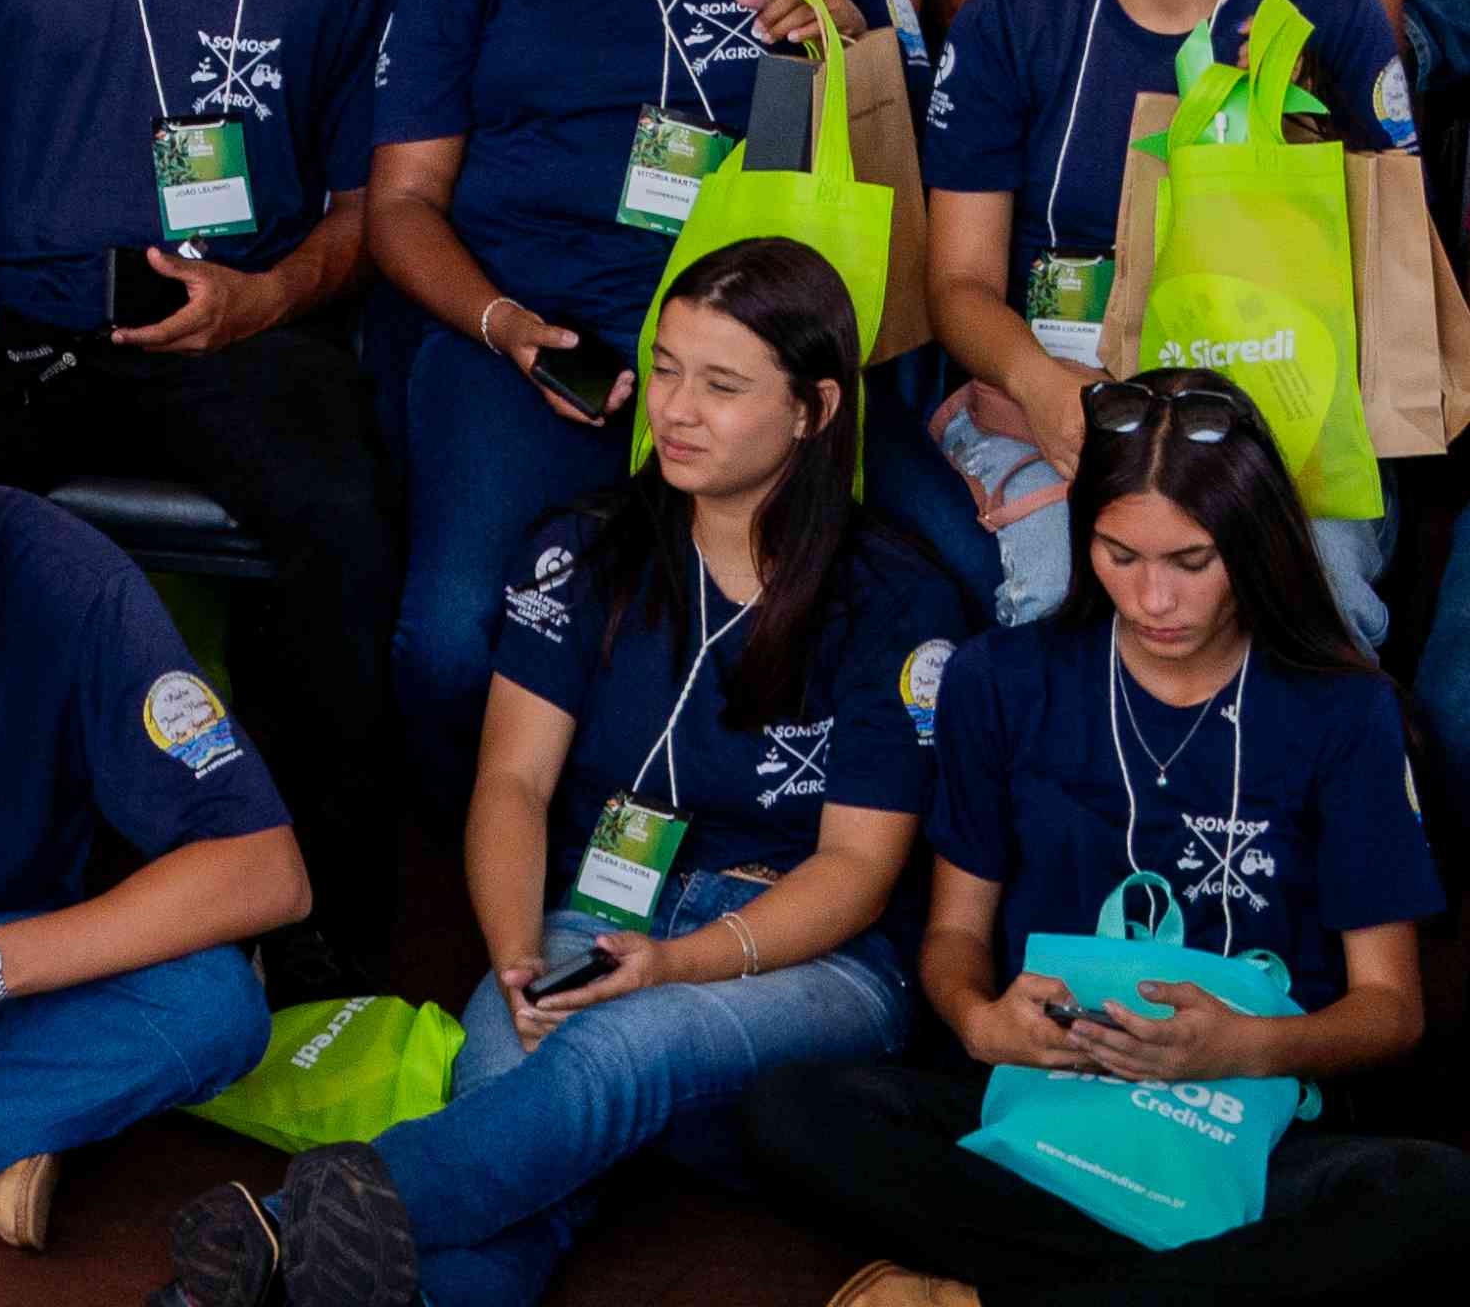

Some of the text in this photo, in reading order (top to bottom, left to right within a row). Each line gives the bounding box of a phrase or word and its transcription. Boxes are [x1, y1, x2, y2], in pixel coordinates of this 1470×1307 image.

[209, 35, 268, 55] SOMOS
[713, 46, 761, 62] AGRO
[211, 91, 253, 109] AGRO
[1193, 330, 1294, 367] Sicredi
[1194, 817, 1257, 838] SOMOS
[1201, 883, 1246, 900] AGRO
[292, 996, 377, 1068] icredi
[1130, 1089, 1238, 1145] Credivar
